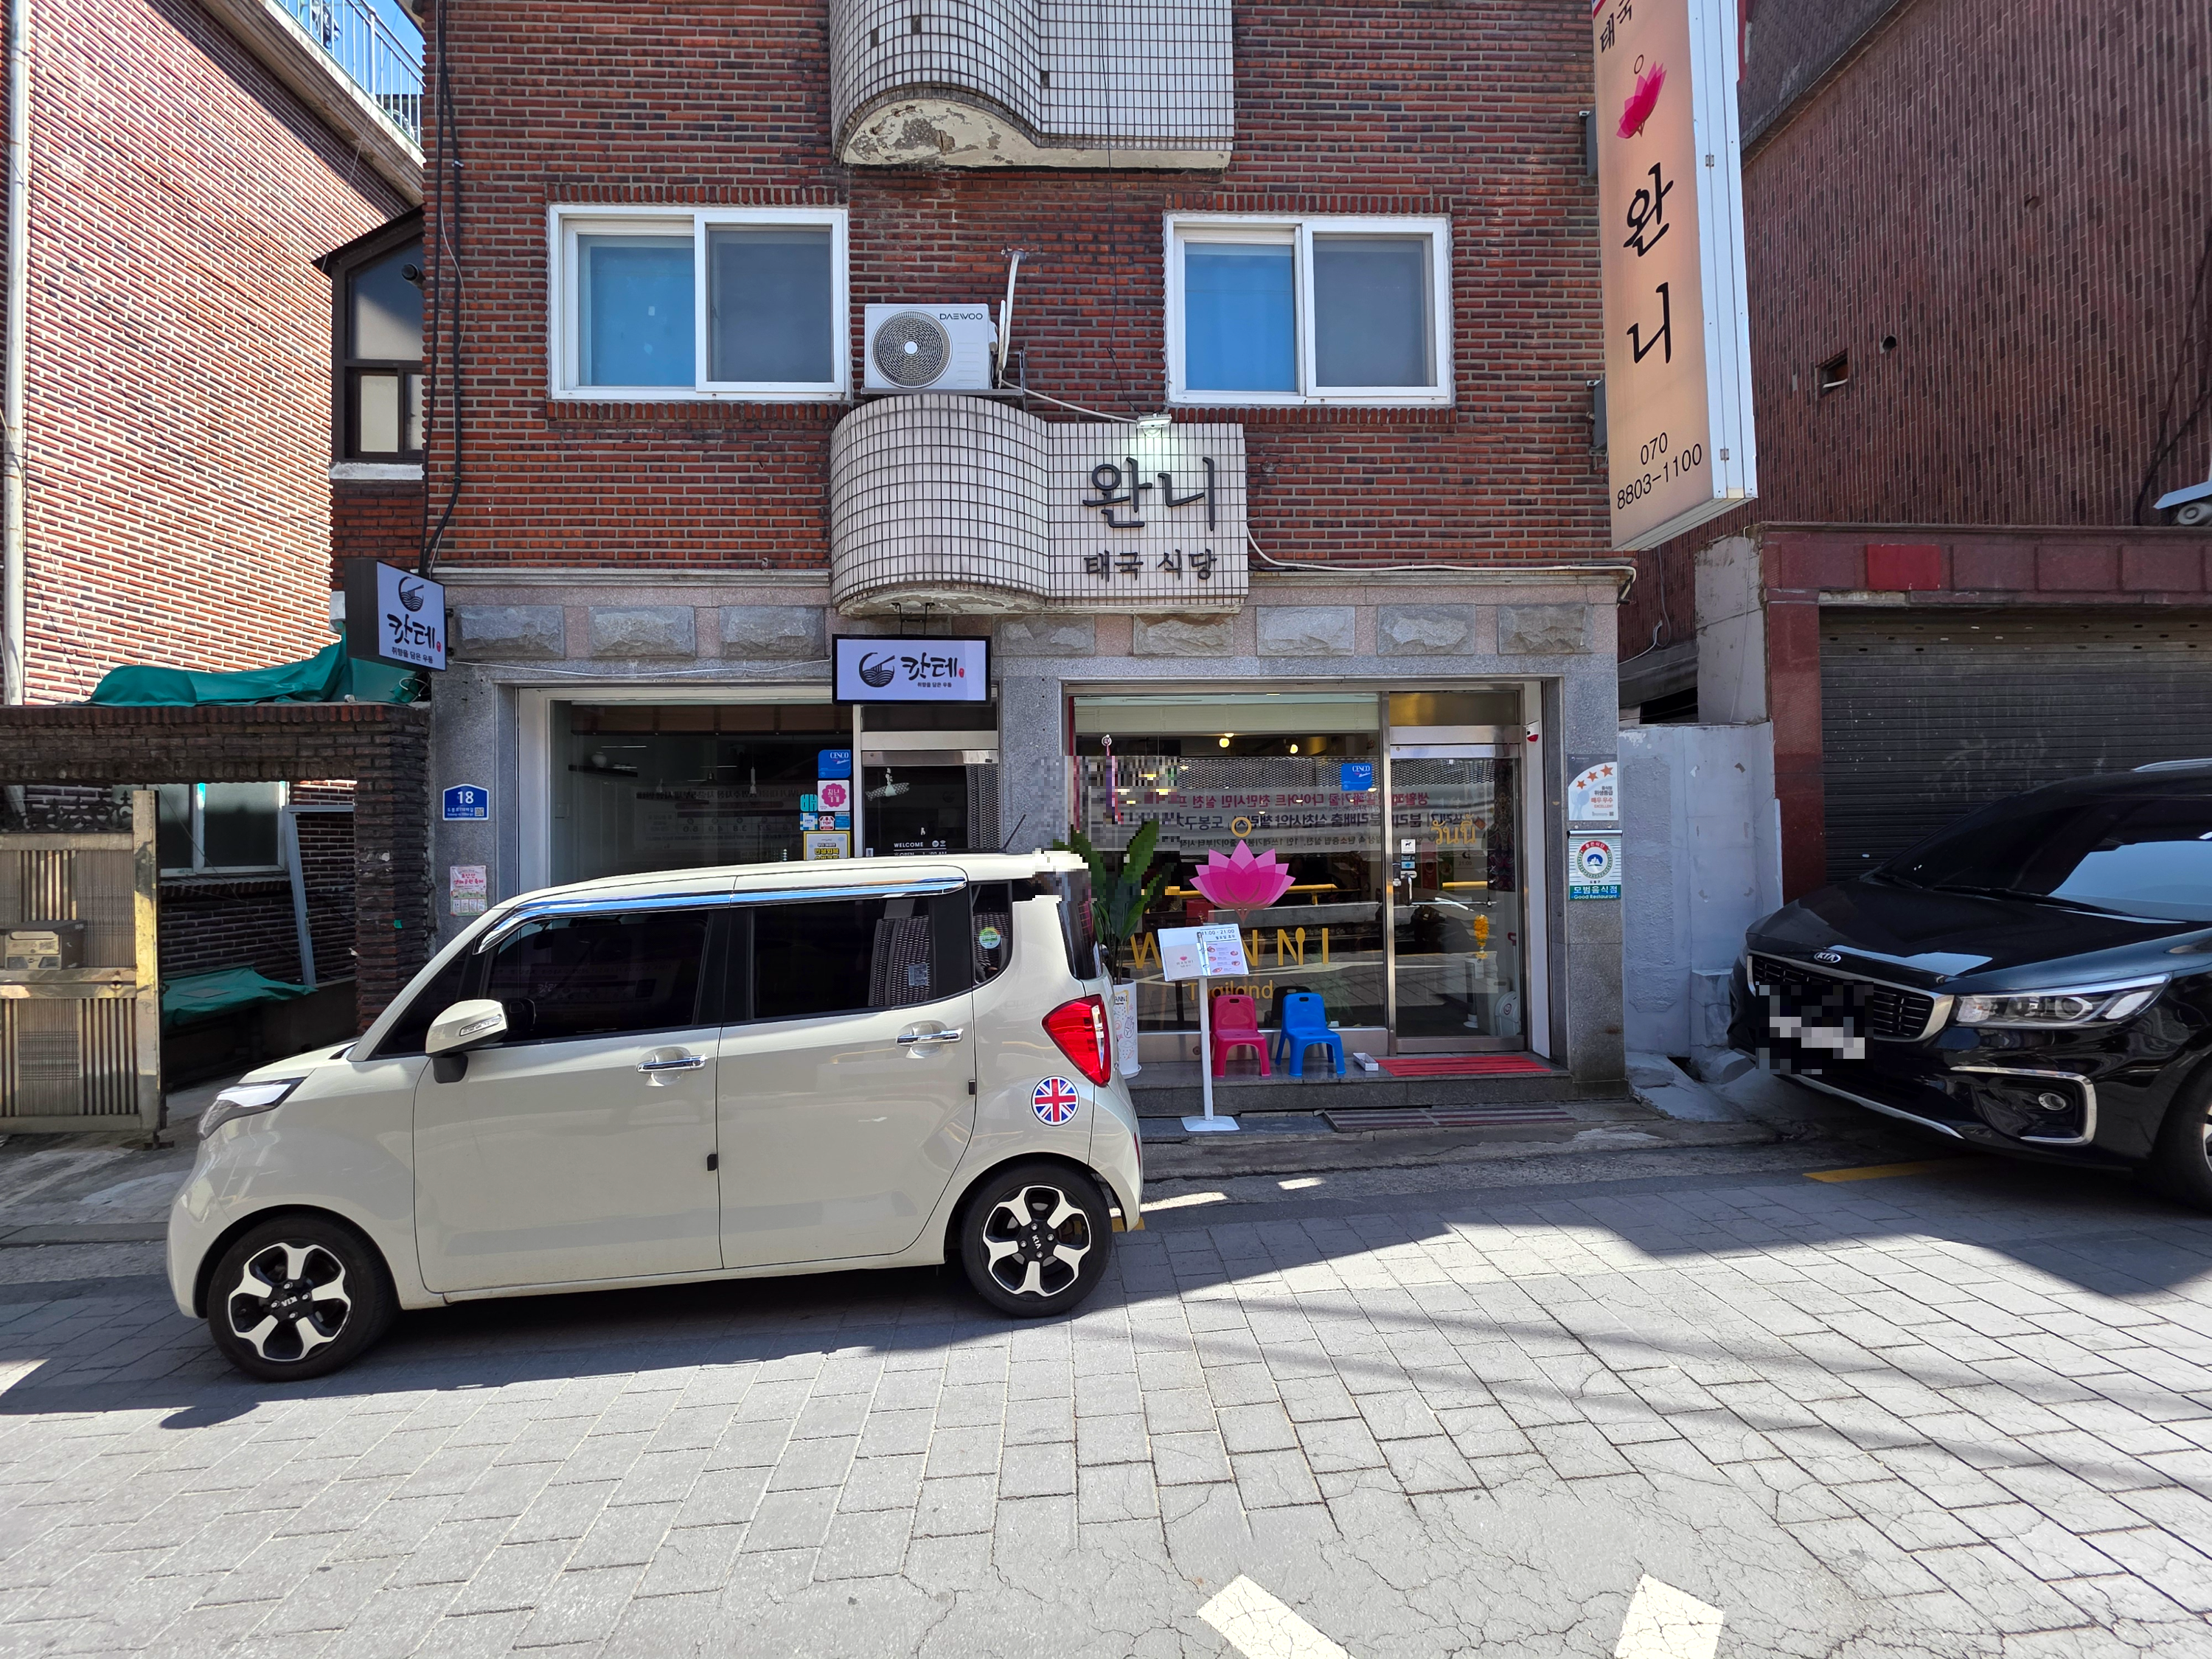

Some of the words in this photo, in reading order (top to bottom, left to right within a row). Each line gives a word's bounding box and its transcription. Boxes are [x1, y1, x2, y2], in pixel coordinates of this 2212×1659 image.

[1623, 161, 1674, 364] 완니
[1641, 432, 1668, 465] 070
[1617, 443, 1703, 509] 8803-1100
[1082, 456, 1215, 532] 완니
[1084, 549, 1144, 582] 태국
[1158, 548, 1217, 581] 식당
[392, 647, 408, 658] 취향을
[409, 651, 421, 661] 담은
[422, 655, 434, 664] 우동
[457, 790, 474, 804] 18
[1573, 886, 1618, 894] 모범음식점
[1130, 927, 1329, 970] WNNI
[1817, 952, 1836, 961] KIA
[1187, 979, 1273, 1001] Tailand
[1032, 1234, 1042, 1250] KIA
[281, 1295, 298, 1307] KIA
